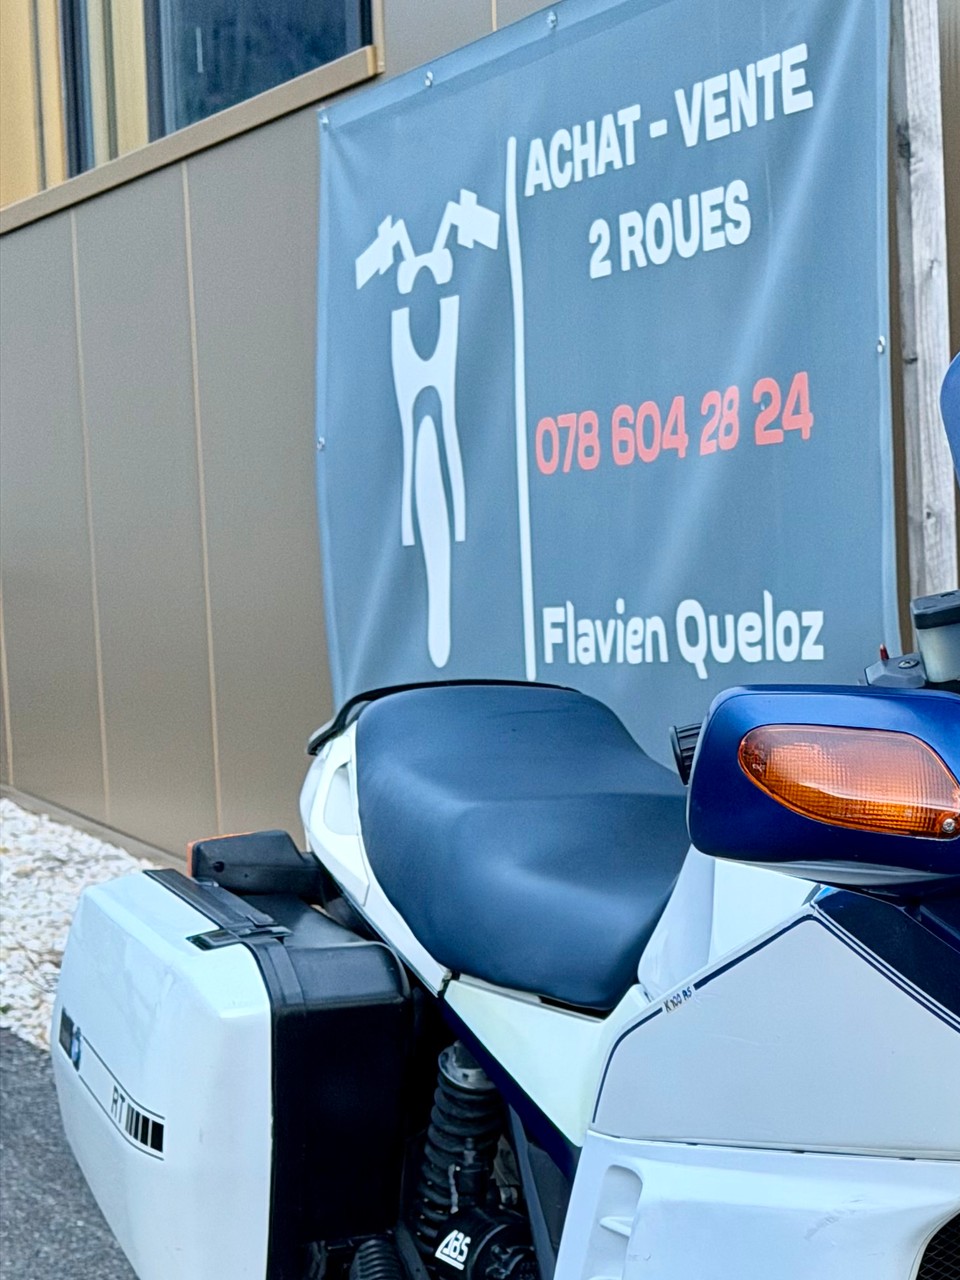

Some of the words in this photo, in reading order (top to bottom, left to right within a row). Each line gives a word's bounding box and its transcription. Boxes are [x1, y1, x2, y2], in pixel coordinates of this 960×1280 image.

[524, 103, 642, 198] ACHAT
[674, 43, 814, 148] VENTE
[588, 218, 612, 280] 2
[618, 178, 752, 272] ROUES
[535, 411, 600, 475] 078
[611, 396, 688, 466] 604
[699, 386, 739, 455] 28
[752, 372, 813, 446] 24
[543, 598, 669, 665] Flavien
[676, 589, 824, 679] Queloz
[111, 1085, 126, 1124] RT
[435, 1229, 471, 1270] ABS
